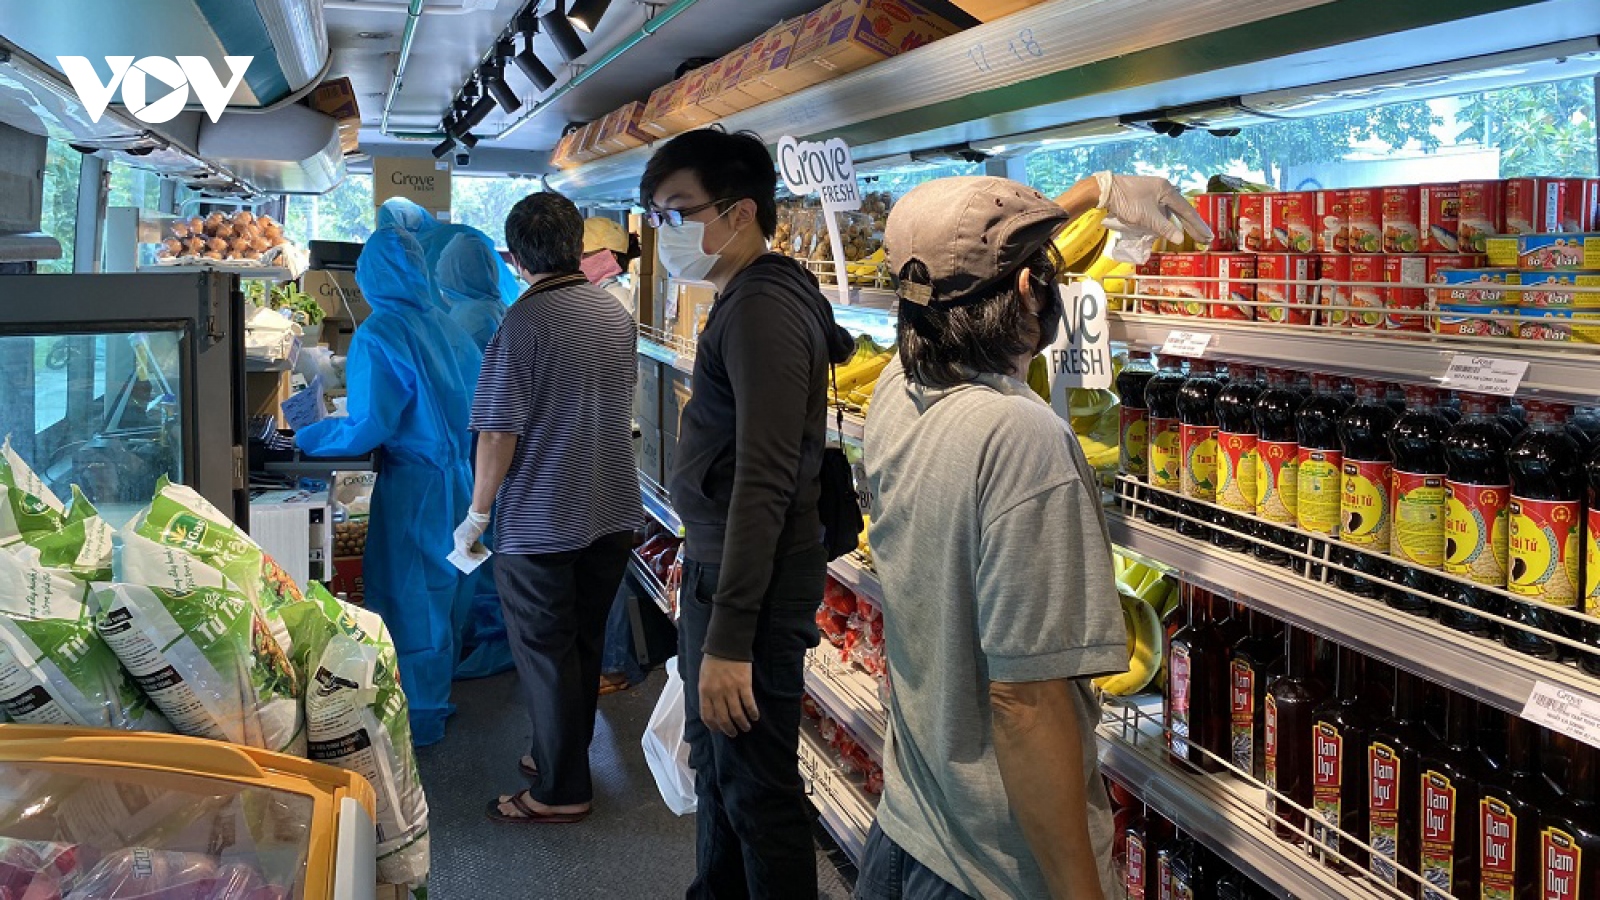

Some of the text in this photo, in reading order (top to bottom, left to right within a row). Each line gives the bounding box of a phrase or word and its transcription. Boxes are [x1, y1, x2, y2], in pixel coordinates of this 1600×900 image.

[782, 143, 851, 187] Grove
[391, 170, 435, 187] Grove
[821, 182, 857, 203] FRESH
[1051, 348, 1104, 376] FRESH
[1318, 736, 1337, 757] Nam
[1373, 758, 1394, 780] Nam
[1426, 787, 1449, 811] Nam
[1485, 813, 1510, 839] Nam
[1547, 845, 1574, 872] Nam
